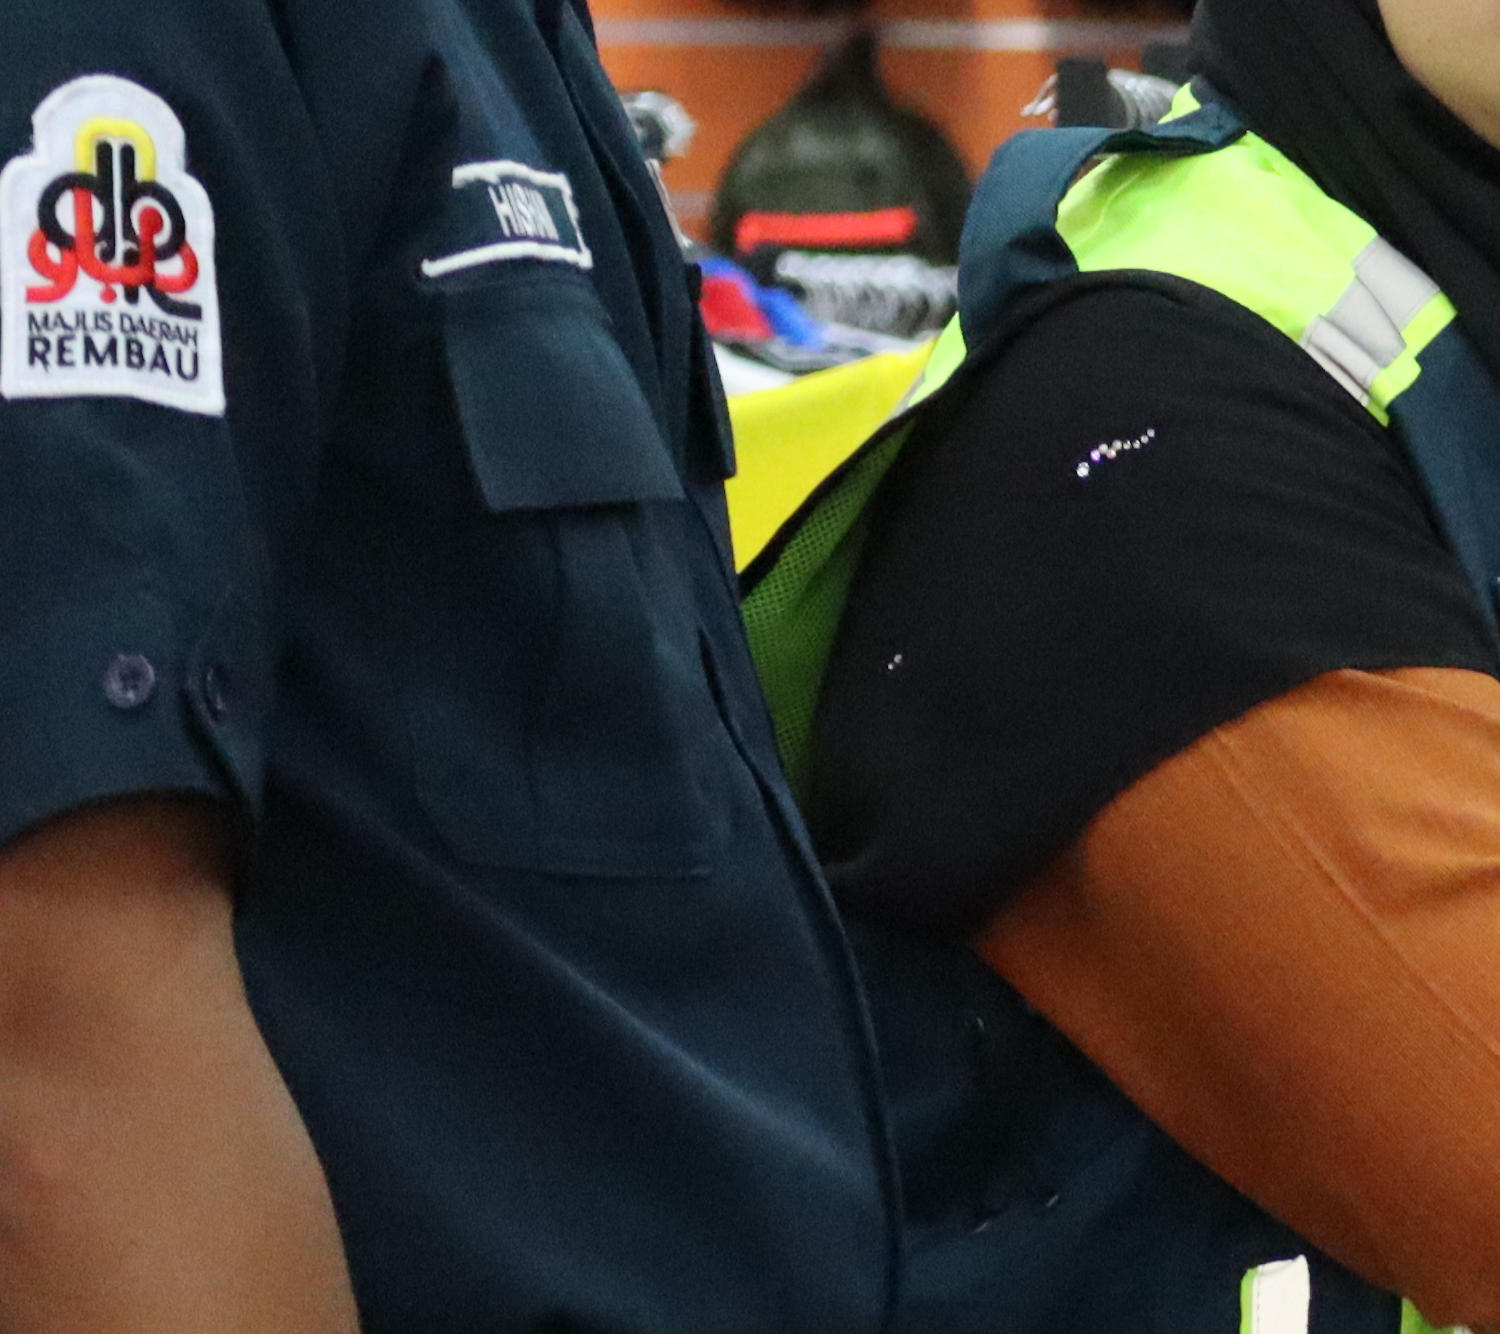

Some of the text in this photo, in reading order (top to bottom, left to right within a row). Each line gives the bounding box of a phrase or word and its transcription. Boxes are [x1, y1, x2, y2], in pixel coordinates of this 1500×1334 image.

[28, 312, 198, 347] MAJLIS DAERAH
[27, 334, 199, 381] REMBAU
